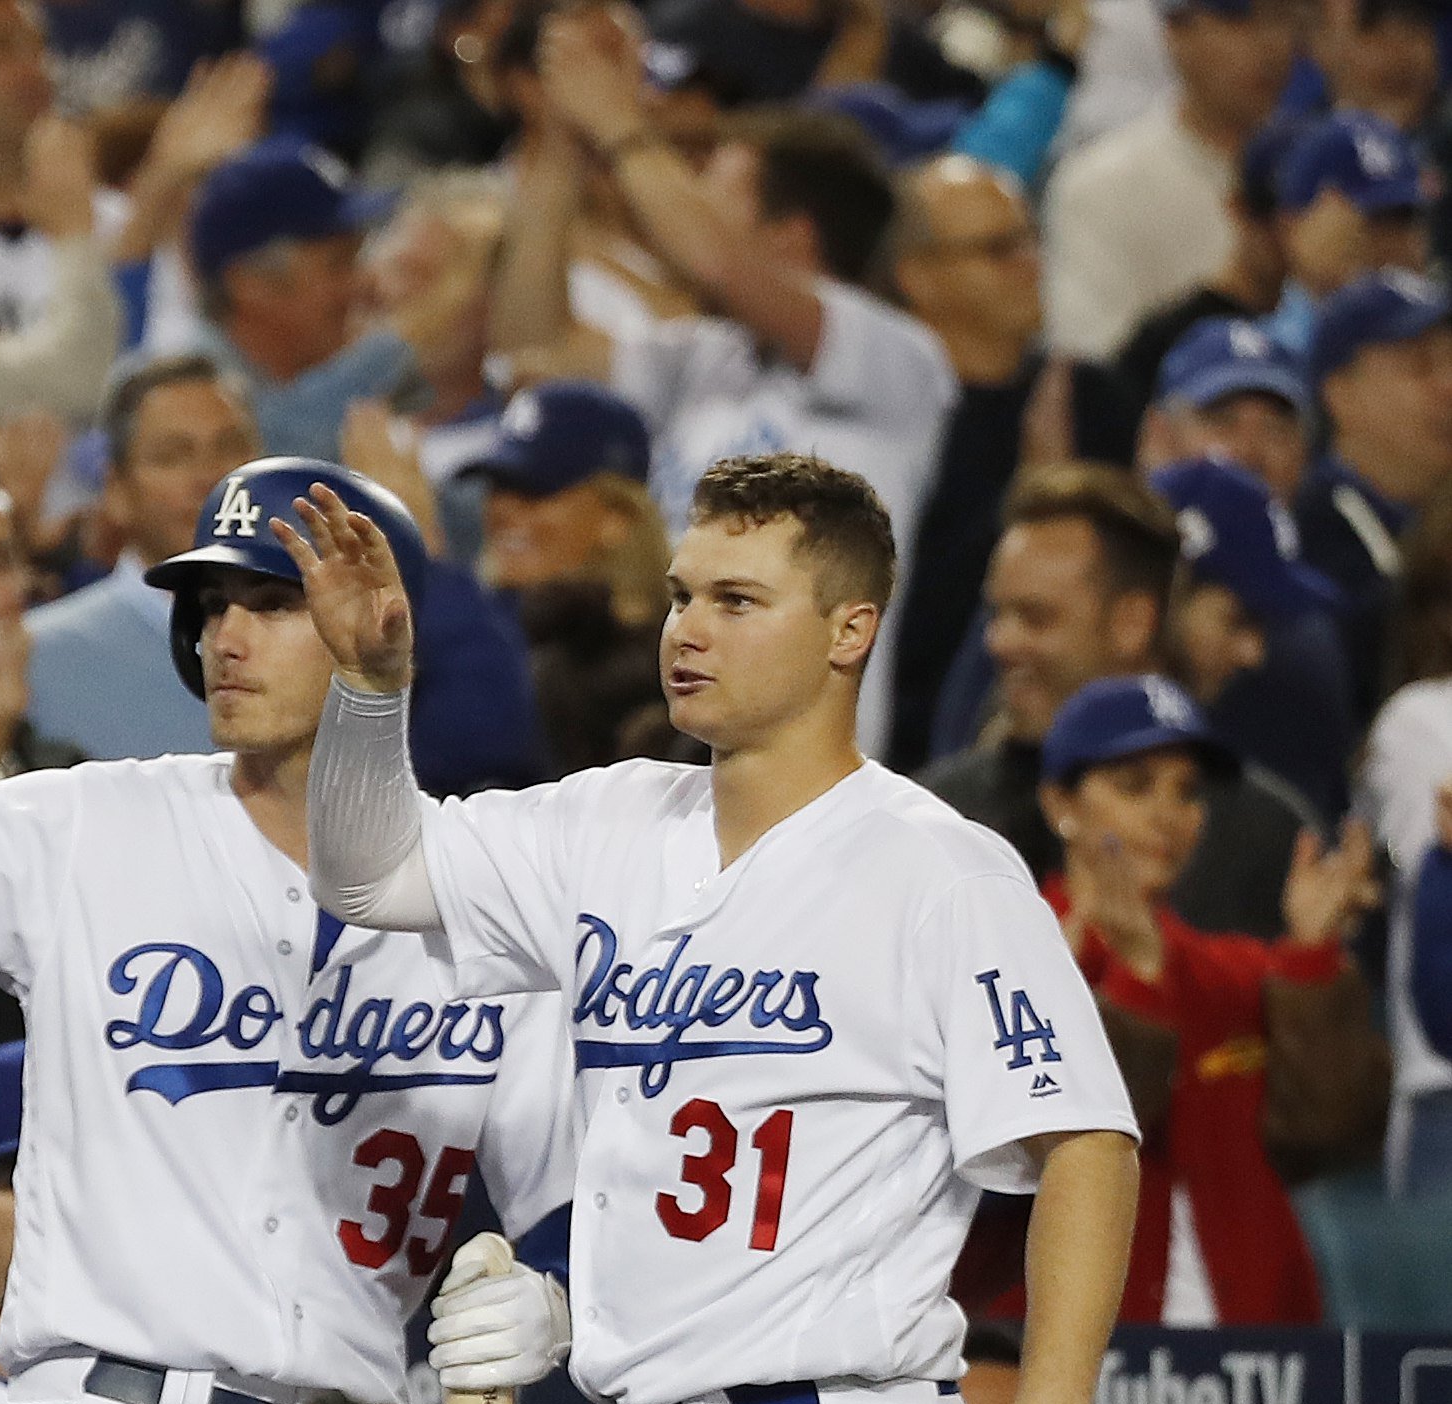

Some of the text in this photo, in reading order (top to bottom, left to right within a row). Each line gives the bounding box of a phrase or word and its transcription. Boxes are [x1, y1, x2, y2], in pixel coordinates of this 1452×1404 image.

[212, 475, 263, 538] LA
[105, 940, 507, 1126] Dodgers
[974, 968, 1062, 1072] LA
[335, 1126, 477, 1279] 35
[654, 1097, 795, 1252] 31
